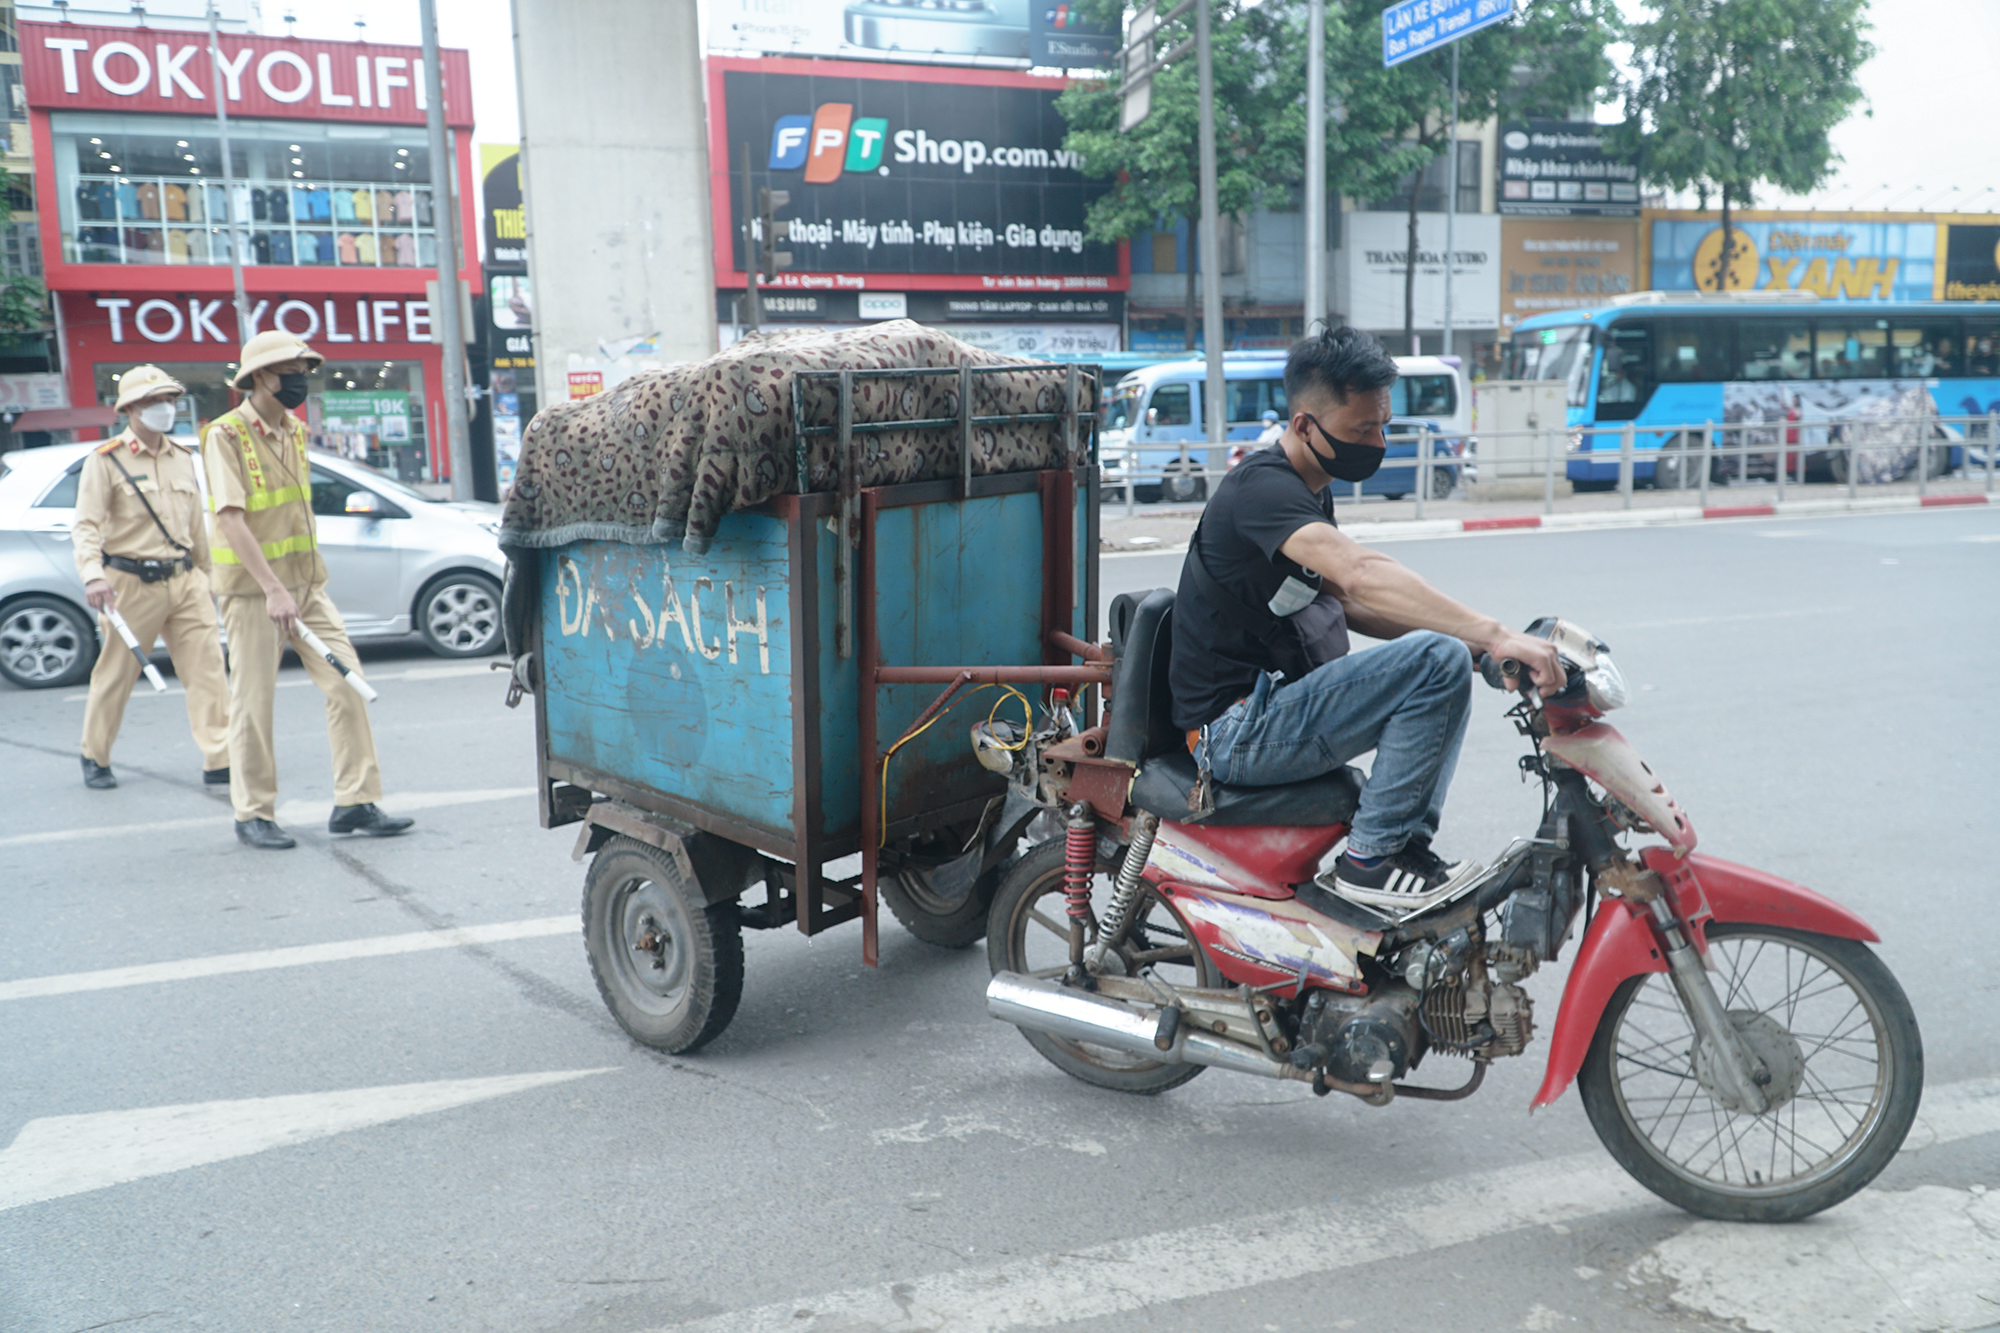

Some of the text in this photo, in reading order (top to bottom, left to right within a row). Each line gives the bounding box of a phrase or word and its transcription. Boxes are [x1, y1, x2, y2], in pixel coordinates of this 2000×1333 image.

[1388, 38, 1407, 56] Bus
[788, 217, 834, 250] thoại
[842, 217, 878, 250] Máy
[880, 218, 915, 245] tính
[922, 219, 956, 253] Phụ
[957, 220, 995, 253] kiện
[1004, 222, 1038, 248] Gia
[1039, 223, 1083, 254] dụng
[801, 275, 833, 289] Quang
[836, 275, 865, 290] Trung
[1762, 256, 1899, 299] XANH
[763, 297, 818, 312] MSUNG
[373, 398, 405, 415] 19K
